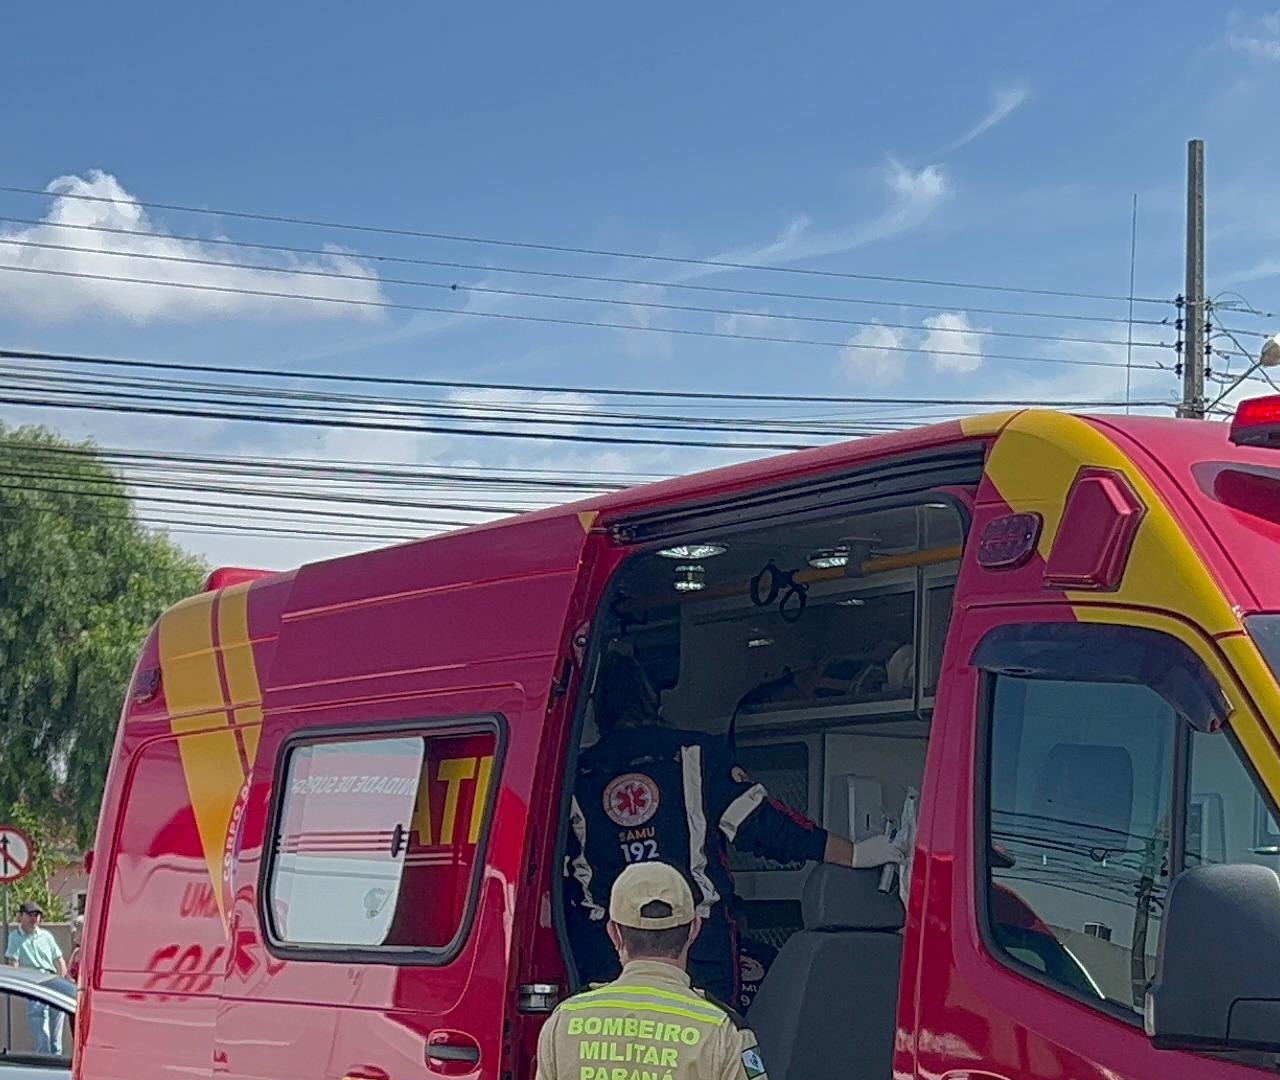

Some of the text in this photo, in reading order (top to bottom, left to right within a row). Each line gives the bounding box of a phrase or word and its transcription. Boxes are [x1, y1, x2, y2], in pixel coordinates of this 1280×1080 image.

[618, 826, 656, 842] SAMU
[620, 839, 660, 863] 192
[567, 1016, 701, 1046] BOMBEIRO
[579, 1040, 679, 1068] MILITAR
